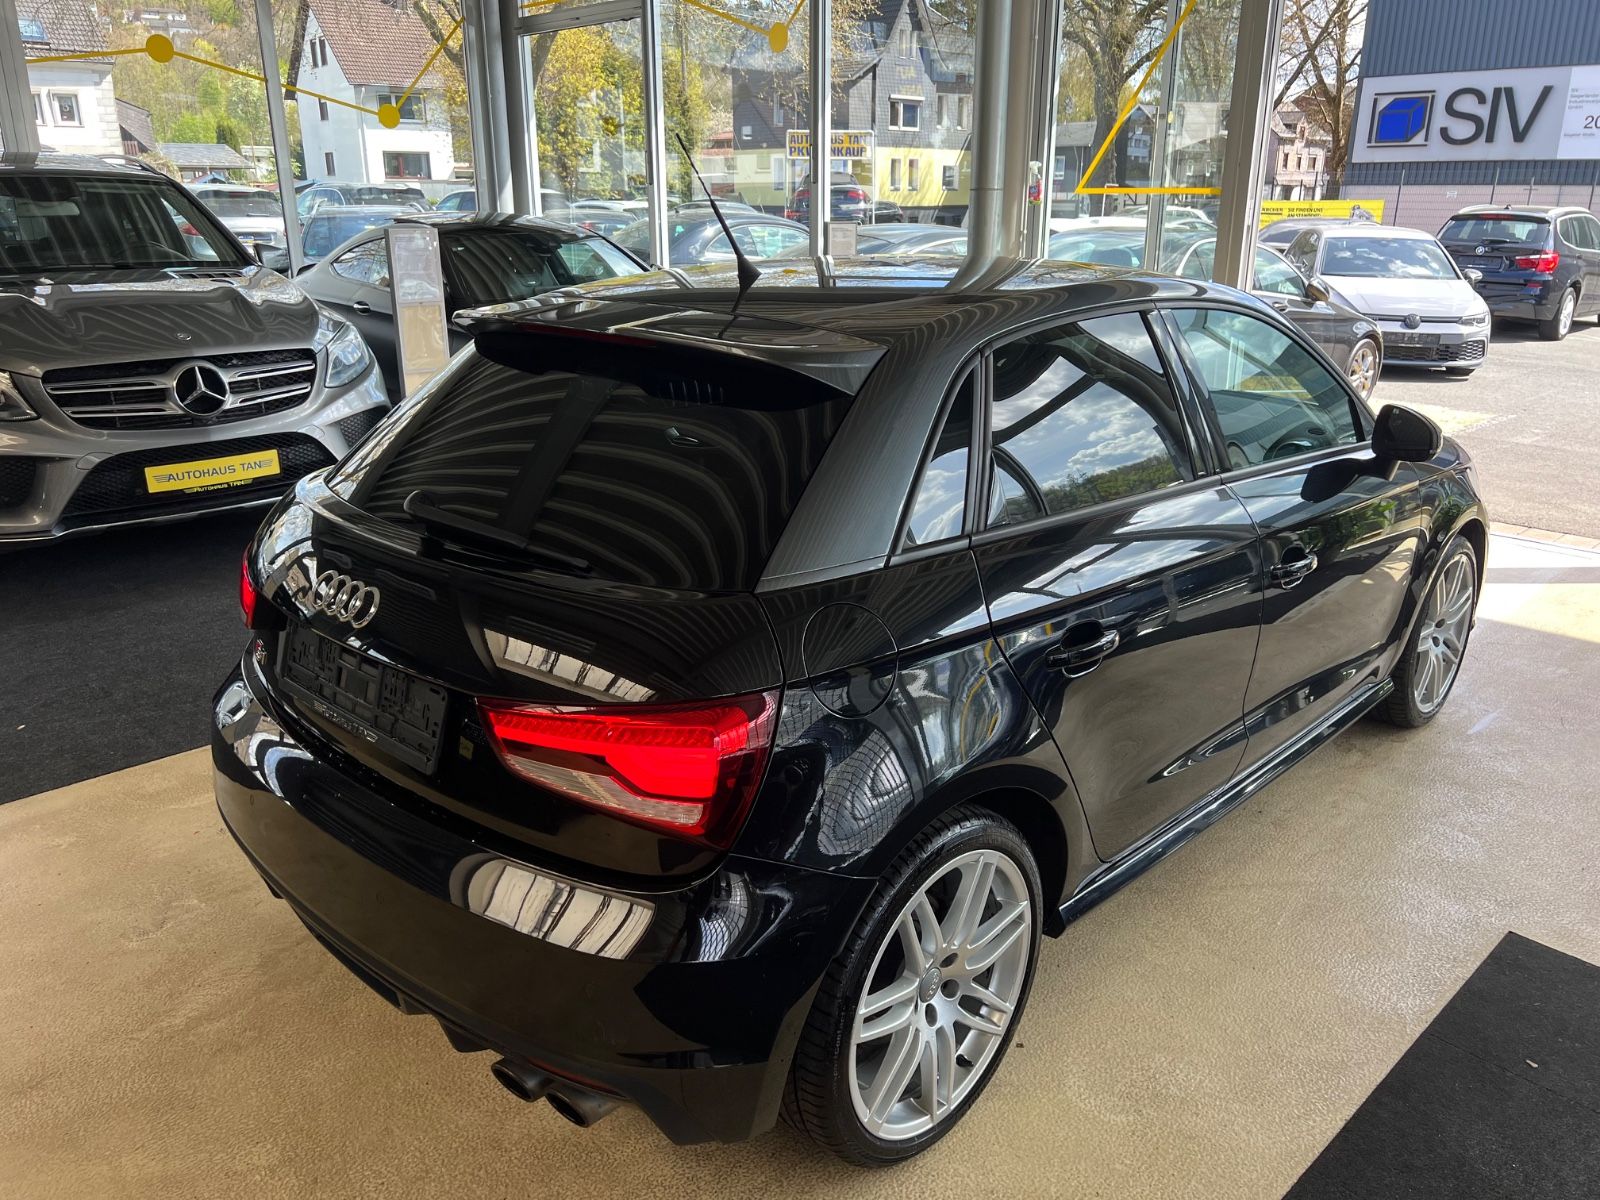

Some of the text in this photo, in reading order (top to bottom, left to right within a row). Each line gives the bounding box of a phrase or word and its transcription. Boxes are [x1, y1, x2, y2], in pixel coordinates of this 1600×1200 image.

[1439, 85, 1554, 145] SIV
[790, 134, 844, 145] AUTUS
[167, 460, 263, 483] AUTOHAUS TAN
